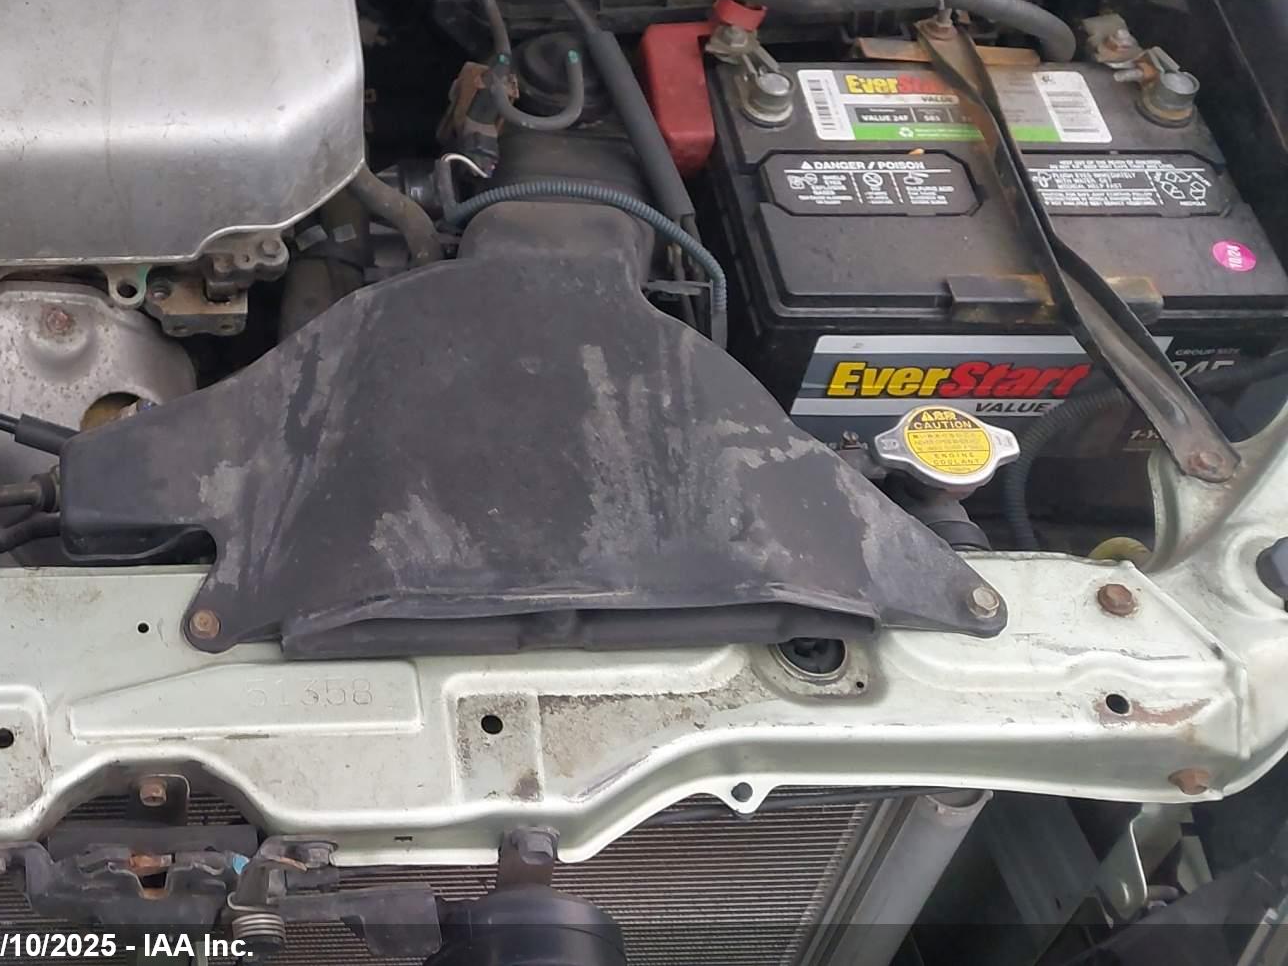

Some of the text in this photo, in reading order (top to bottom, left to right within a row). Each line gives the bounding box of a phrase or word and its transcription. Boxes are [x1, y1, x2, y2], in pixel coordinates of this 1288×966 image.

[813, 161, 866, 170] DANGER
[878, 161, 925, 170] POISON
[826, 360, 1090, 398] EverStart
[975, 402, 1050, 414] VALUE
[913, 420, 972, 430] CAUTION
